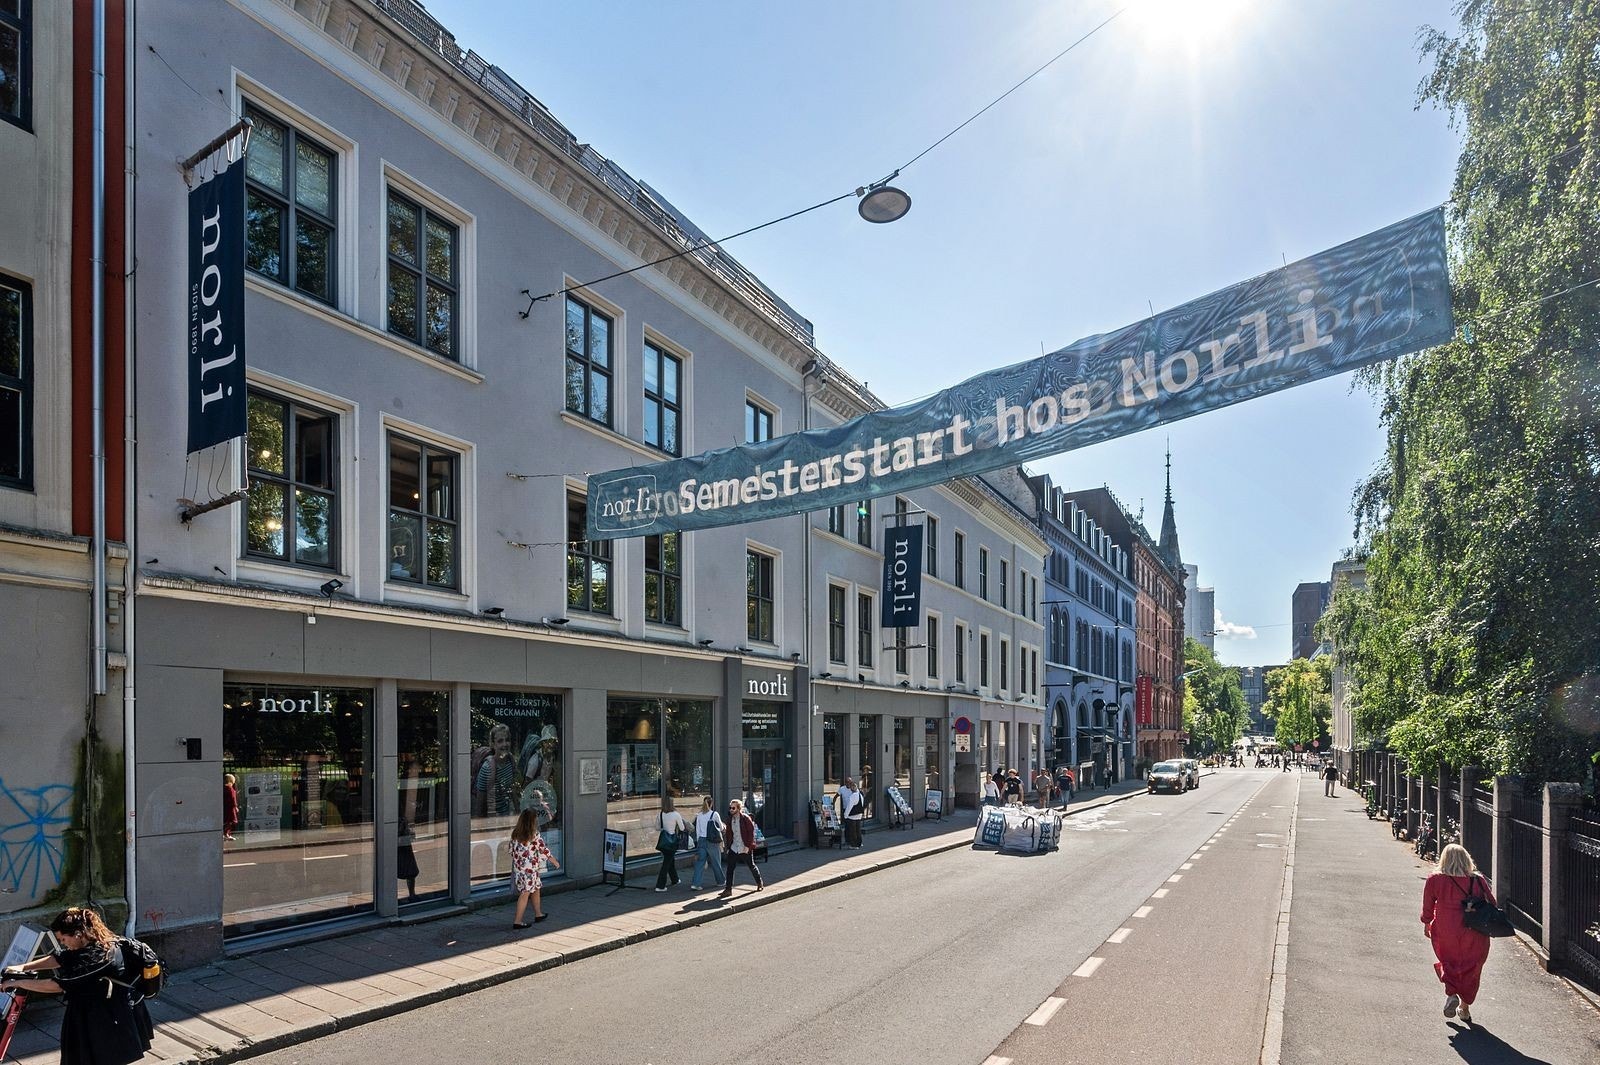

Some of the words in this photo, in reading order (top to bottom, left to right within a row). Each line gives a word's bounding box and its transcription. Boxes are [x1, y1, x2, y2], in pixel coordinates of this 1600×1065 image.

[191, 283, 199, 322] SIDEN
[201, 204, 237, 414] norli
[680, 413, 974, 514] Semesterstart
[996, 380, 1093, 447] hos
[1120, 288, 1334, 409] Norli
[601, 486, 652, 517] norli
[893, 538, 916, 615] norli
[747, 673, 788, 696] norli
[258, 690, 332, 713] norli
[482, 697, 507, 705] NORLI
[514, 698, 540, 707] STØRST
[494, 708, 540, 717] BECKMANN!
